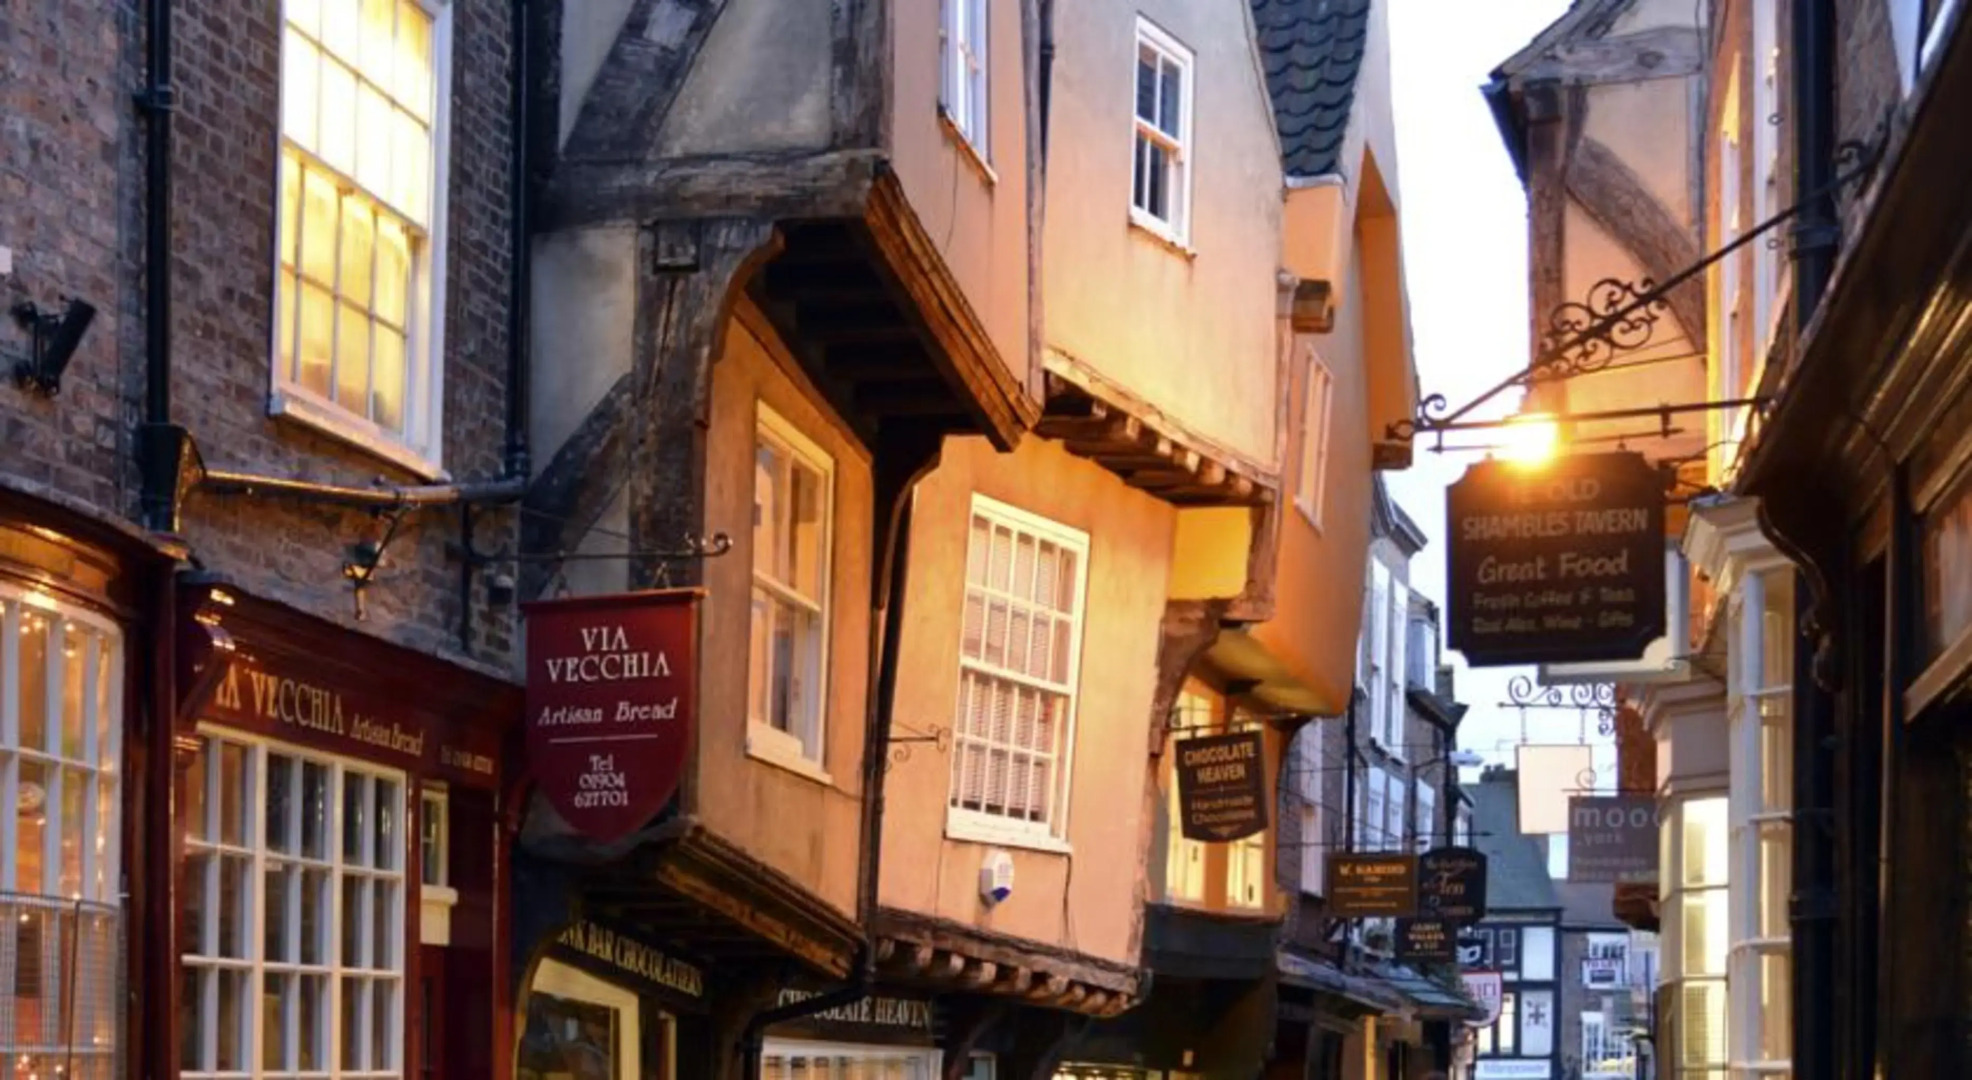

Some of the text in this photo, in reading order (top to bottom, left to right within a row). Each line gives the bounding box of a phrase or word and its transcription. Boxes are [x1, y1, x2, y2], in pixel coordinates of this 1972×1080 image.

[1462, 507, 1648, 541] SHAMBLES TAVERN
[1477, 550, 1629, 584] Great Food
[581, 626, 629, 652] VIA
[547, 652, 672, 682] VECCHIA
[251, 670, 345, 735] VECCHIA
[351, 713, 392, 748] Artisan
[538, 697, 679, 727] Artisan Bread
[589, 754, 614, 771] Tel
[1184, 741, 1255, 768] CHOCOLATE
[1197, 763, 1246, 785] HEAVEN
[875, 996, 932, 1028] HEAVEN
